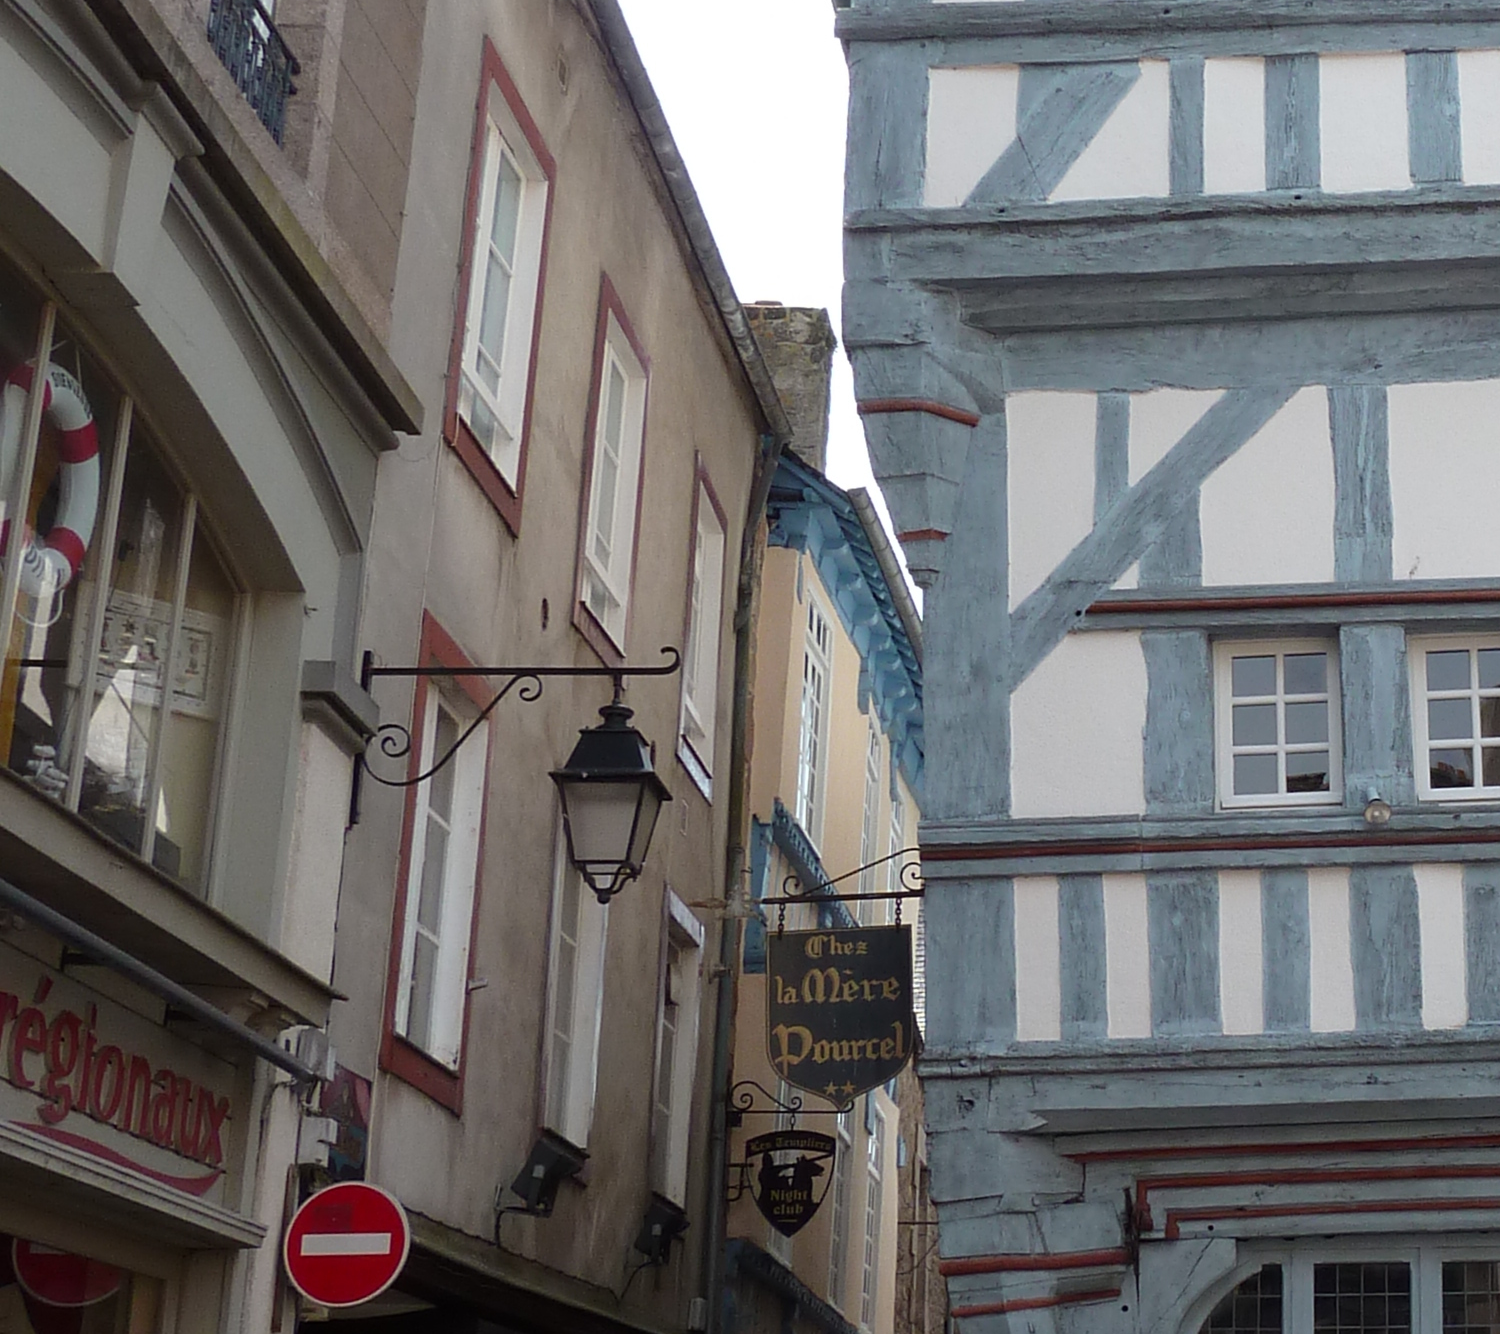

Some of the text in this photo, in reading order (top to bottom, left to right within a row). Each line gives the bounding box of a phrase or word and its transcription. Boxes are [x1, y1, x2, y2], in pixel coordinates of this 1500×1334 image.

[805, 934, 869, 959] Chez
[775, 967, 901, 1004] la Mère
[772, 1021, 905, 1077] Pourcel
[770, 1190, 808, 1203] Night
[773, 1204, 804, 1215] club
